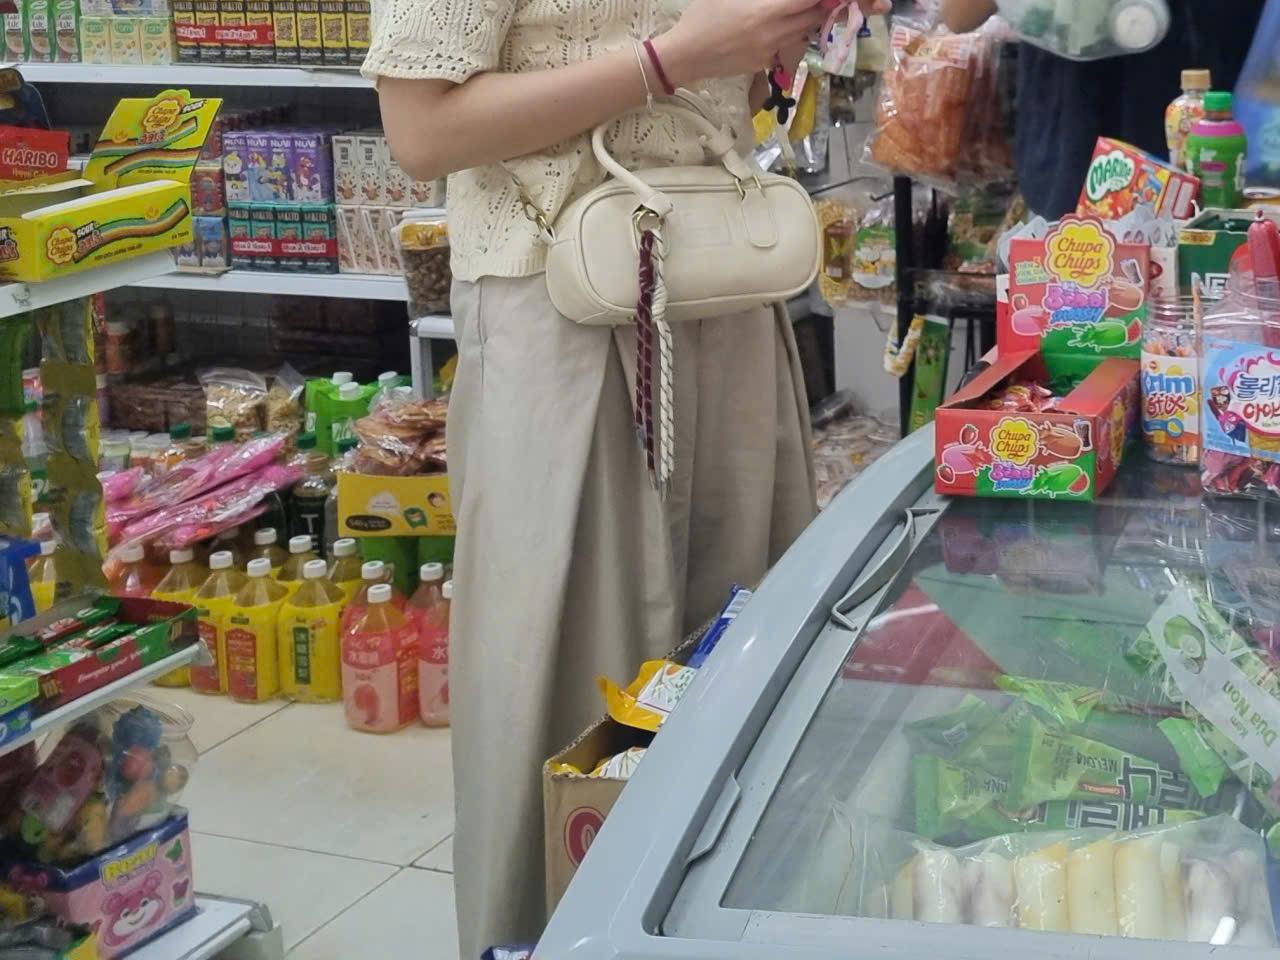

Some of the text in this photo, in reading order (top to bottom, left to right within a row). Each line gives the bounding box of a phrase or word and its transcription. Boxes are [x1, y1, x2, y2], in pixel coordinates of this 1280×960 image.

[3, 149, 58, 168] HARIBO
[75, 224, 96, 237] SOUR
[1057, 237, 1104, 256] Chupa
[1054, 253, 1101, 271] Chups
[998, 430, 1032, 445] Chupa
[996, 441, 1030, 458] Chups
